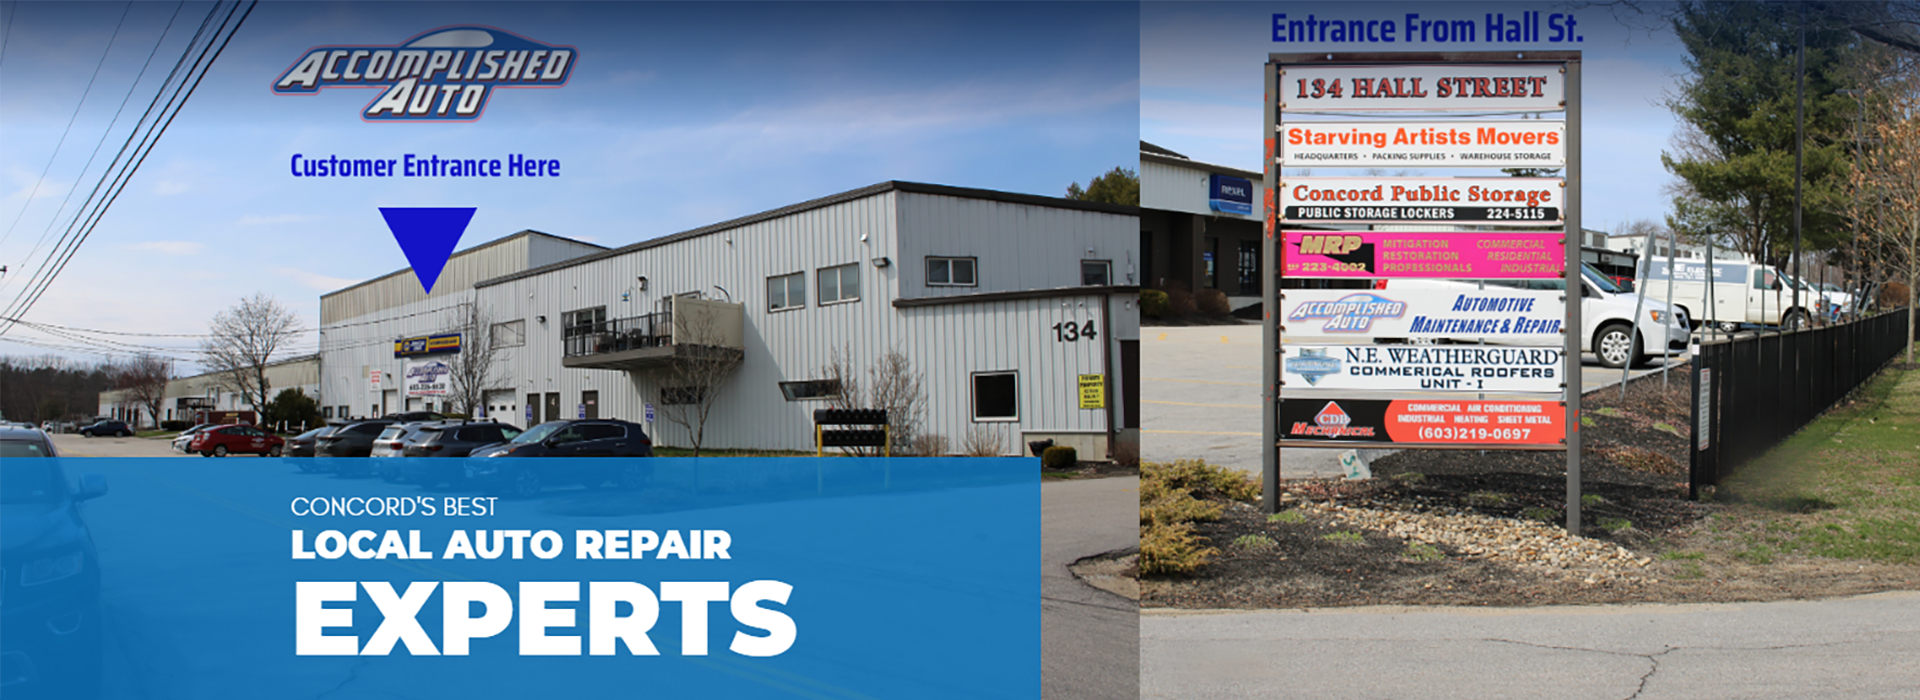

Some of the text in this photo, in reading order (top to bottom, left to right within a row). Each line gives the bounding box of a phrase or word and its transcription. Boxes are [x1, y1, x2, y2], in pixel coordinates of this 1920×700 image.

[1297, 76, 1547, 98] 134 HALL STREET
[1288, 128, 1559, 148] Starving Artists Movers
[1293, 185, 1551, 208] Concord Public Storage
[1298, 208, 1545, 219] PUBLIC STORAGE LOCKERS 224-5115
[1299, 235, 1363, 255] MRP
[1383, 239, 1449, 249] MITIGATION
[1477, 239, 1545, 249] COMMERCIAL
[1383, 251, 1459, 260] RESTORATION
[1487, 251, 1552, 261] RESIDENTIAL
[1383, 263, 1472, 273] PROFESSIONALS
[1501, 263, 1561, 273] INDUSTRIAL
[1291, 302, 1402, 318] ACCOMPLISHED
[1452, 294, 1536, 312] AUTOMOTIVE
[1324, 313, 1370, 329] AUTO
[1409, 316, 1561, 334] MAINTENANCE & REPAIR
[1052, 320, 1097, 342] 134
[1345, 347, 1559, 365] N.E. WEATHERGUARD
[1350, 366, 1554, 378] COMMERICAL ROOFERS
[1420, 379, 1461, 388] UNIT
[1408, 404, 1542, 413] COMMERCIAL AIR CONDITIONING
[1398, 414, 1552, 424] INDUSTRIAL HEATING SHEET METAL
[1290, 422, 1376, 436] MECHANICAL
[1418, 426, 1531, 440] (603)219-0697
